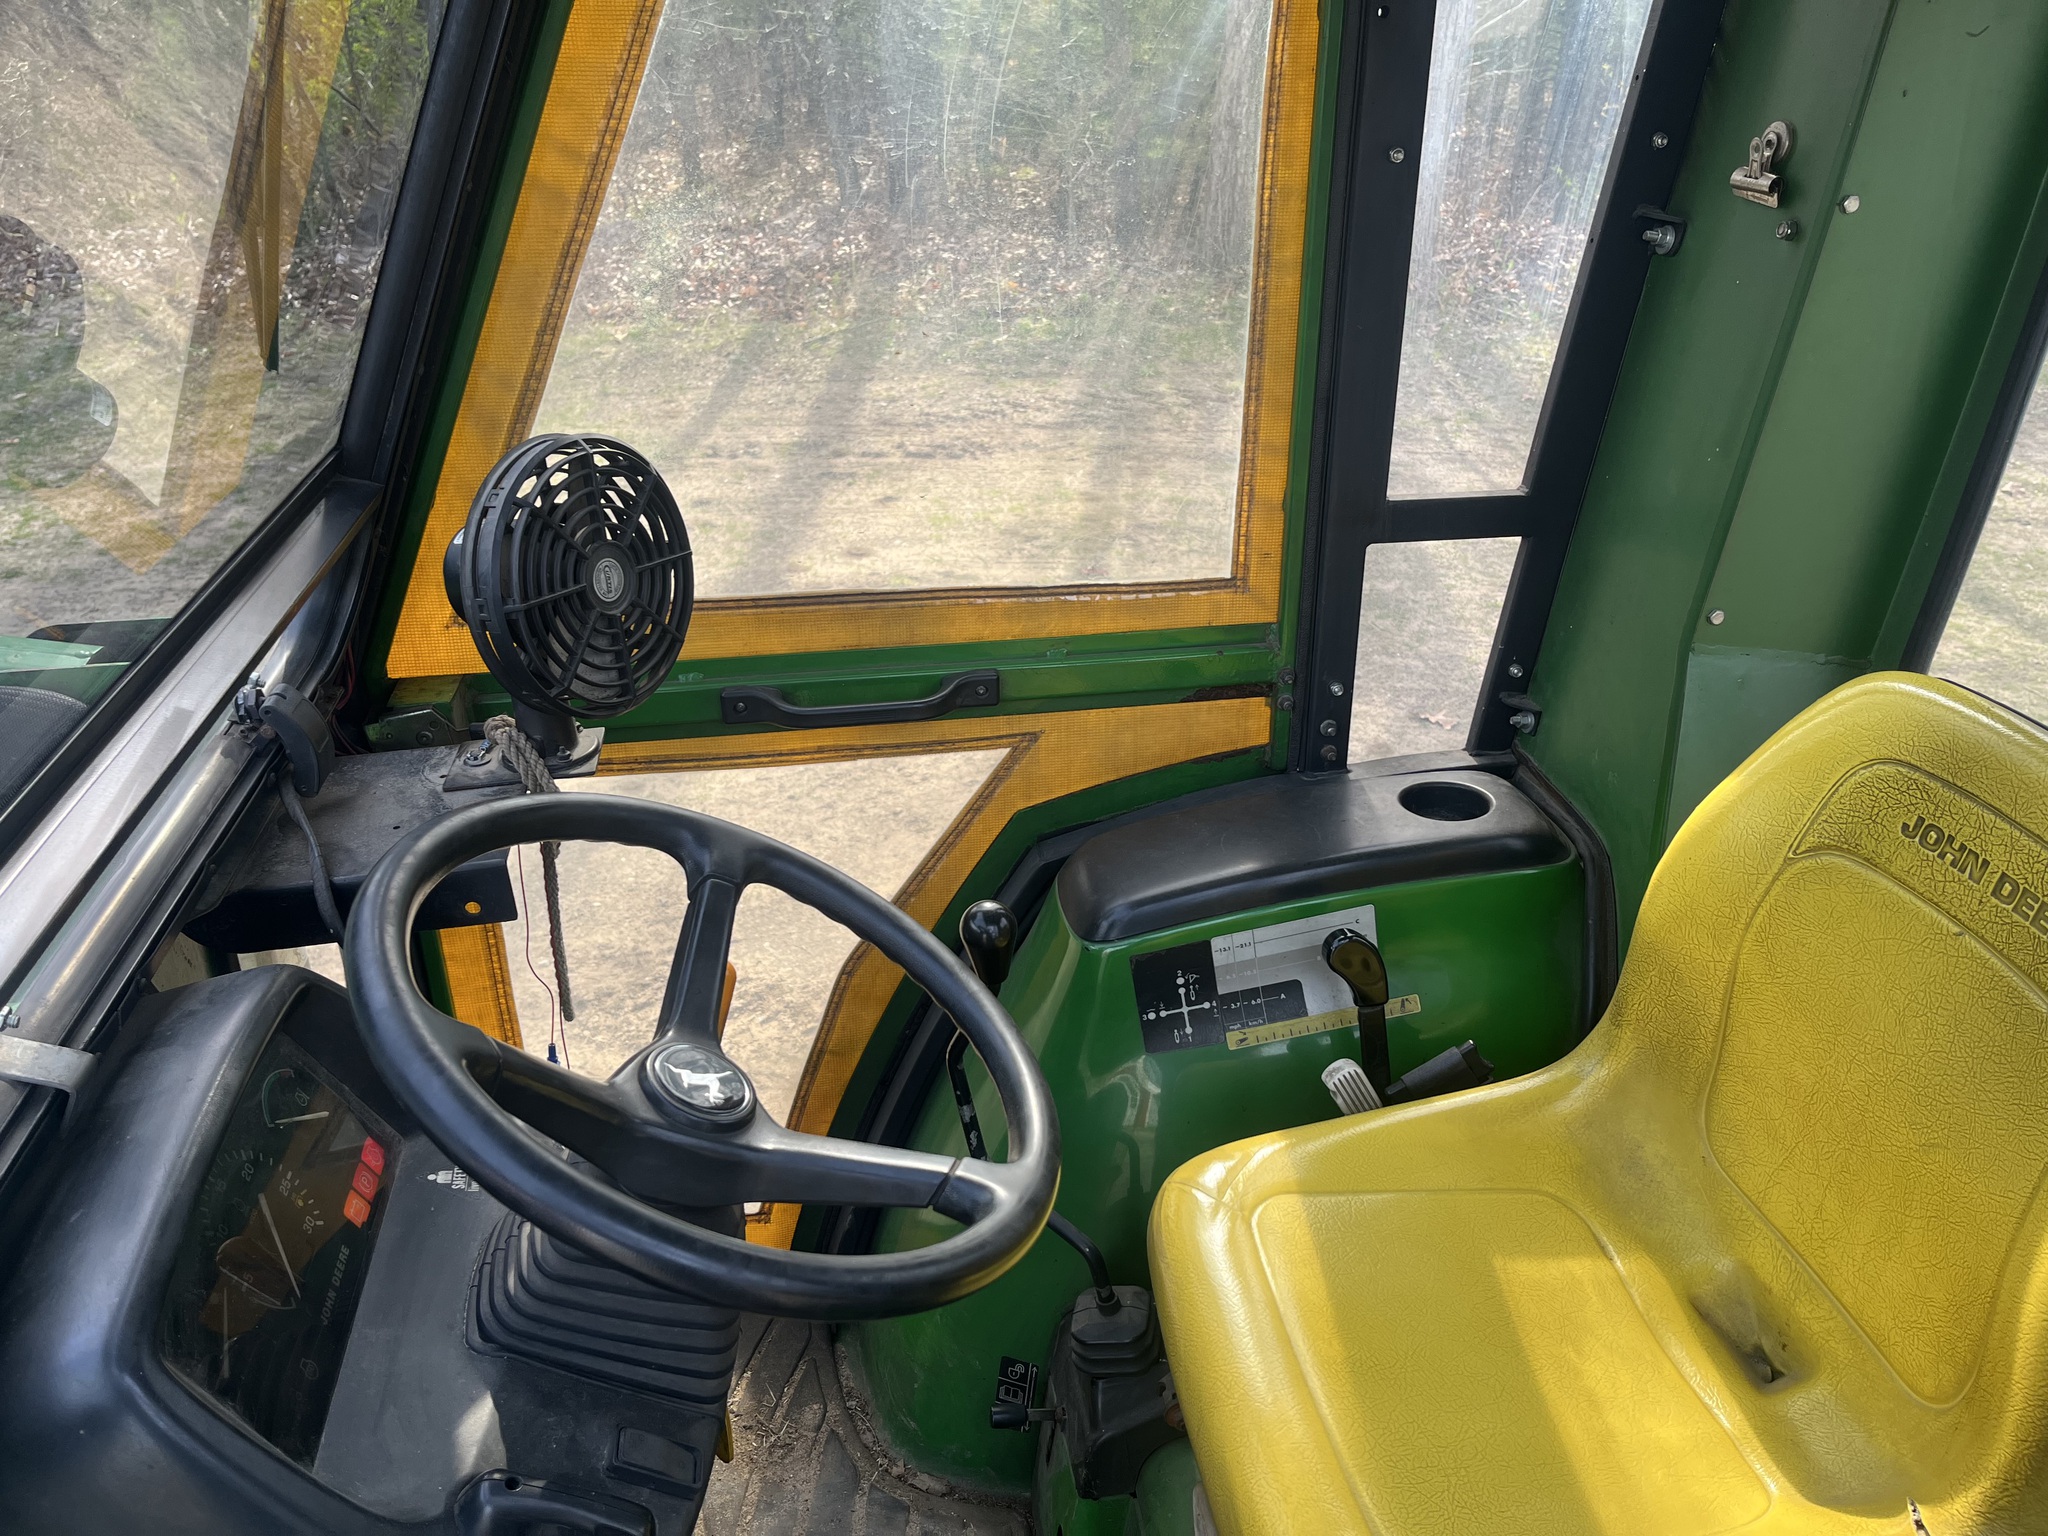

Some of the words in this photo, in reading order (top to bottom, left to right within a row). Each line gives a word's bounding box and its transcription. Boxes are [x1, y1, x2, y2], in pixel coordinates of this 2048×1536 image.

[1901, 815, 1991, 886] JOHN
[1990, 871, 2048, 937] DEE
[1176, 969, 1183, 977] 2
[1248, 1018, 1264, 1026] km/h
[241, 1162, 254, 1182] 20
[279, 1178, 292, 1197] 25
[302, 1215, 315, 1234] 30
[321, 1289, 337, 1325] JOHN
[332, 1244, 350, 1287] DEERE
